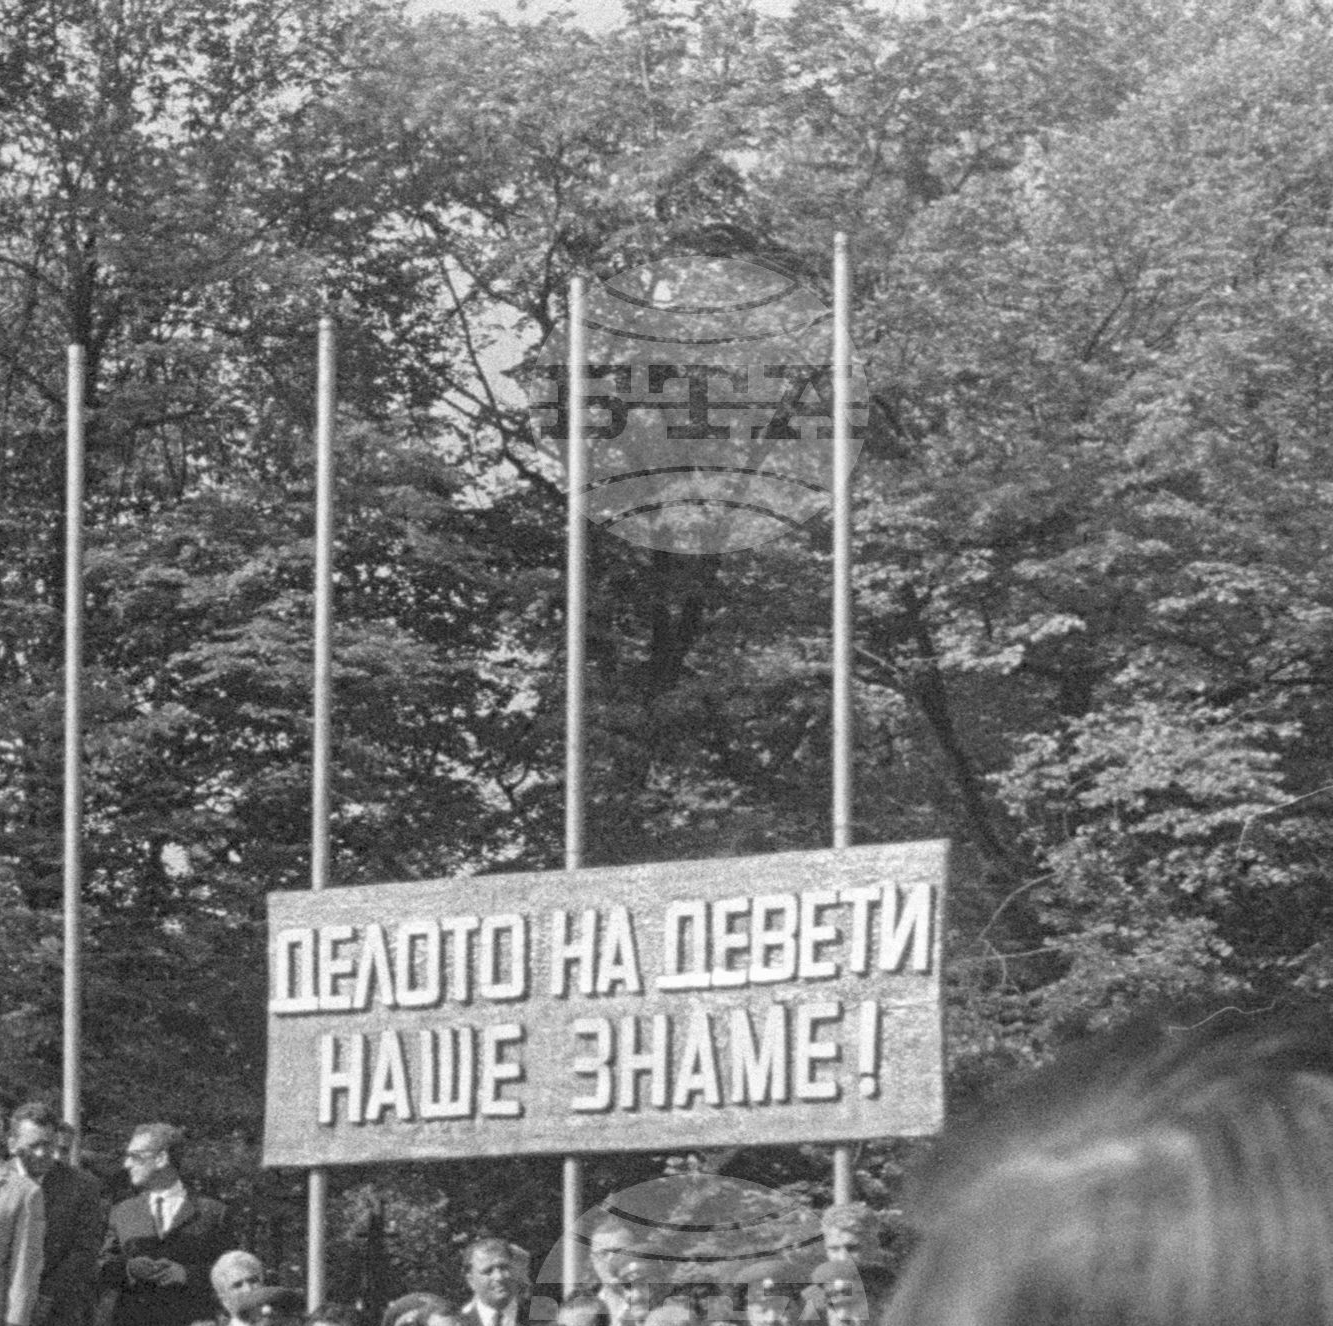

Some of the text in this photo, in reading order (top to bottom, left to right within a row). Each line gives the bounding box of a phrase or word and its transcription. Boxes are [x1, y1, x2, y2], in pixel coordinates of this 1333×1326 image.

[268, 882, 935, 1016] ДЕЛОТО НА ДЕВЕТИ
[317, 1001, 881, 1124] НАШЕ ЗНАМЕ!
